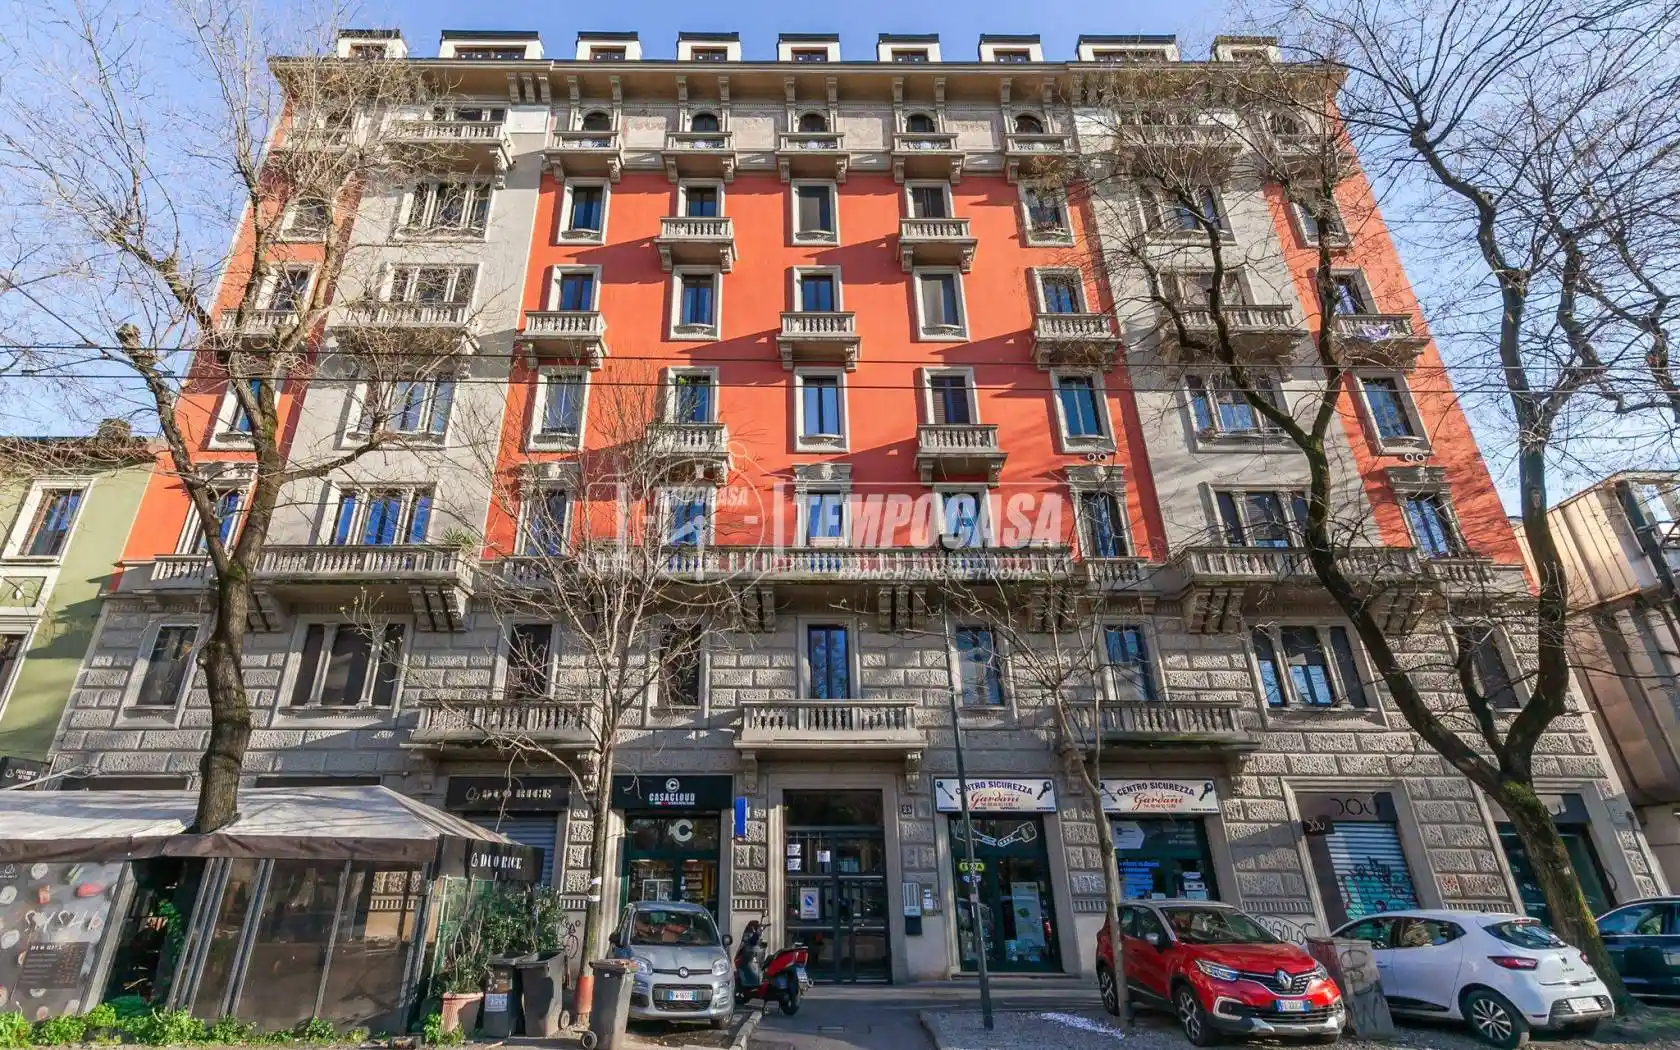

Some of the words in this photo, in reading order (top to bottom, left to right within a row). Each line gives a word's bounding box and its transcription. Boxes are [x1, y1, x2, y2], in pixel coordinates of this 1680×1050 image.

[516, 789, 552, 798] RICE
[955, 781, 986, 795] CNTRO
[988, 780, 1033, 795] SICUREZZA
[1117, 782, 1148, 797] CENTRO
[1150, 782, 1195, 797] SICUREZZA
[648, 793, 696, 802] CASACLOUD
[970, 790, 1020, 810] Gardani
[1132, 791, 1184, 811] Gardani
[480, 852, 500, 868] DUO
[501, 855, 523, 870] RICE
